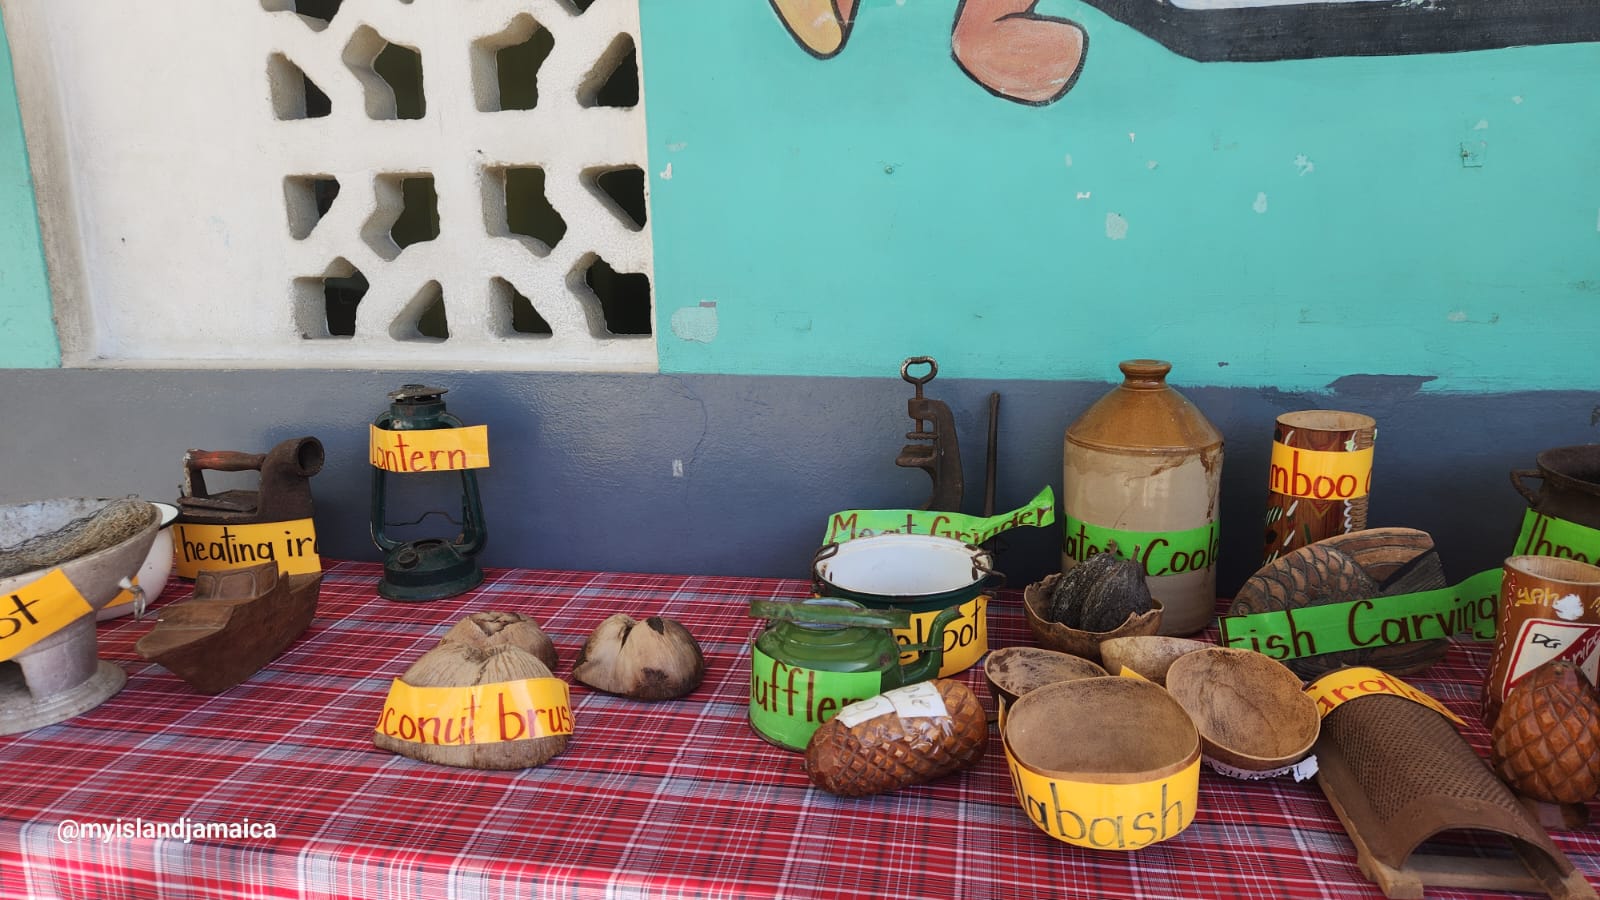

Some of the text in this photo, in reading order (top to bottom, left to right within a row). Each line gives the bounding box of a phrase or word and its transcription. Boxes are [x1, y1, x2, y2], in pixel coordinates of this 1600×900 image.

[831, 513, 918, 544] Met
[1219, 594, 1498, 662] Fish Carving
[1532, 632, 1562, 649] DG
